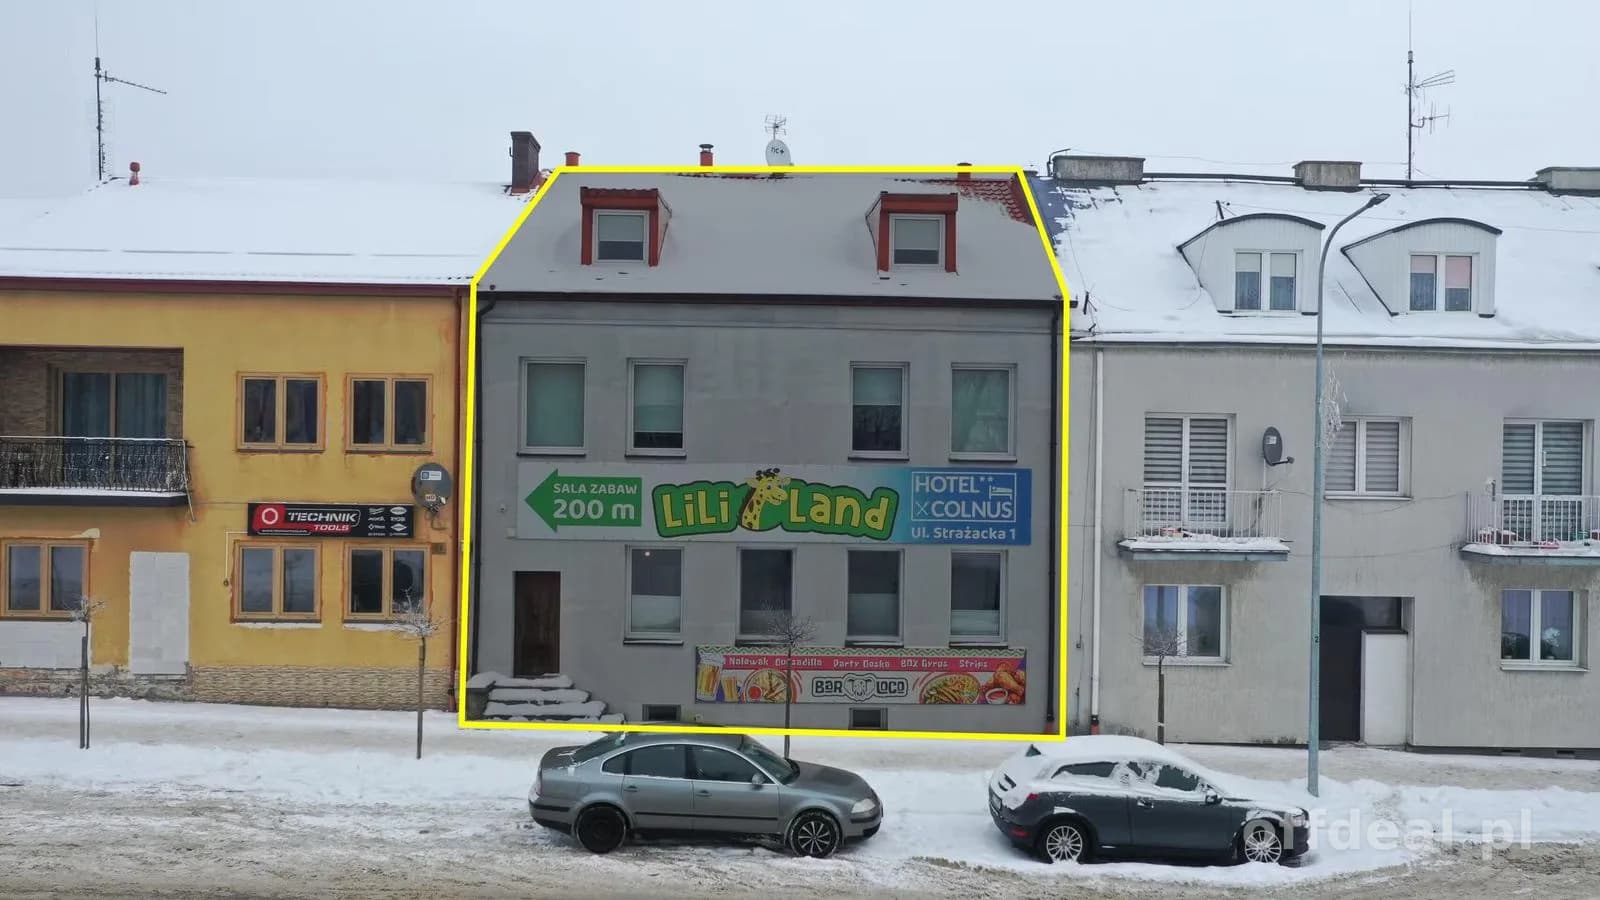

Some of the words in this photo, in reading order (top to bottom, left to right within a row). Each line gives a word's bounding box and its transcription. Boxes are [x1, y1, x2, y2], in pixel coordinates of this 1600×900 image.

[553, 483, 587, 494] SALA
[590, 483, 637, 495] ZABAW
[553, 498, 604, 520] 200
[611, 502, 635, 520] m
[790, 488, 889, 531] Land
[287, 511, 358, 523] TECHNIK
[313, 524, 350, 532] TOOLS
[933, 526, 1006, 540] Strażacka
[1010, 528, 1016, 540] 1
[775, 658, 823, 667] Qusadilla
[833, 658, 860, 668] Party
[921, 659, 950, 669] Gyros
[959, 659, 989, 669] Strips
